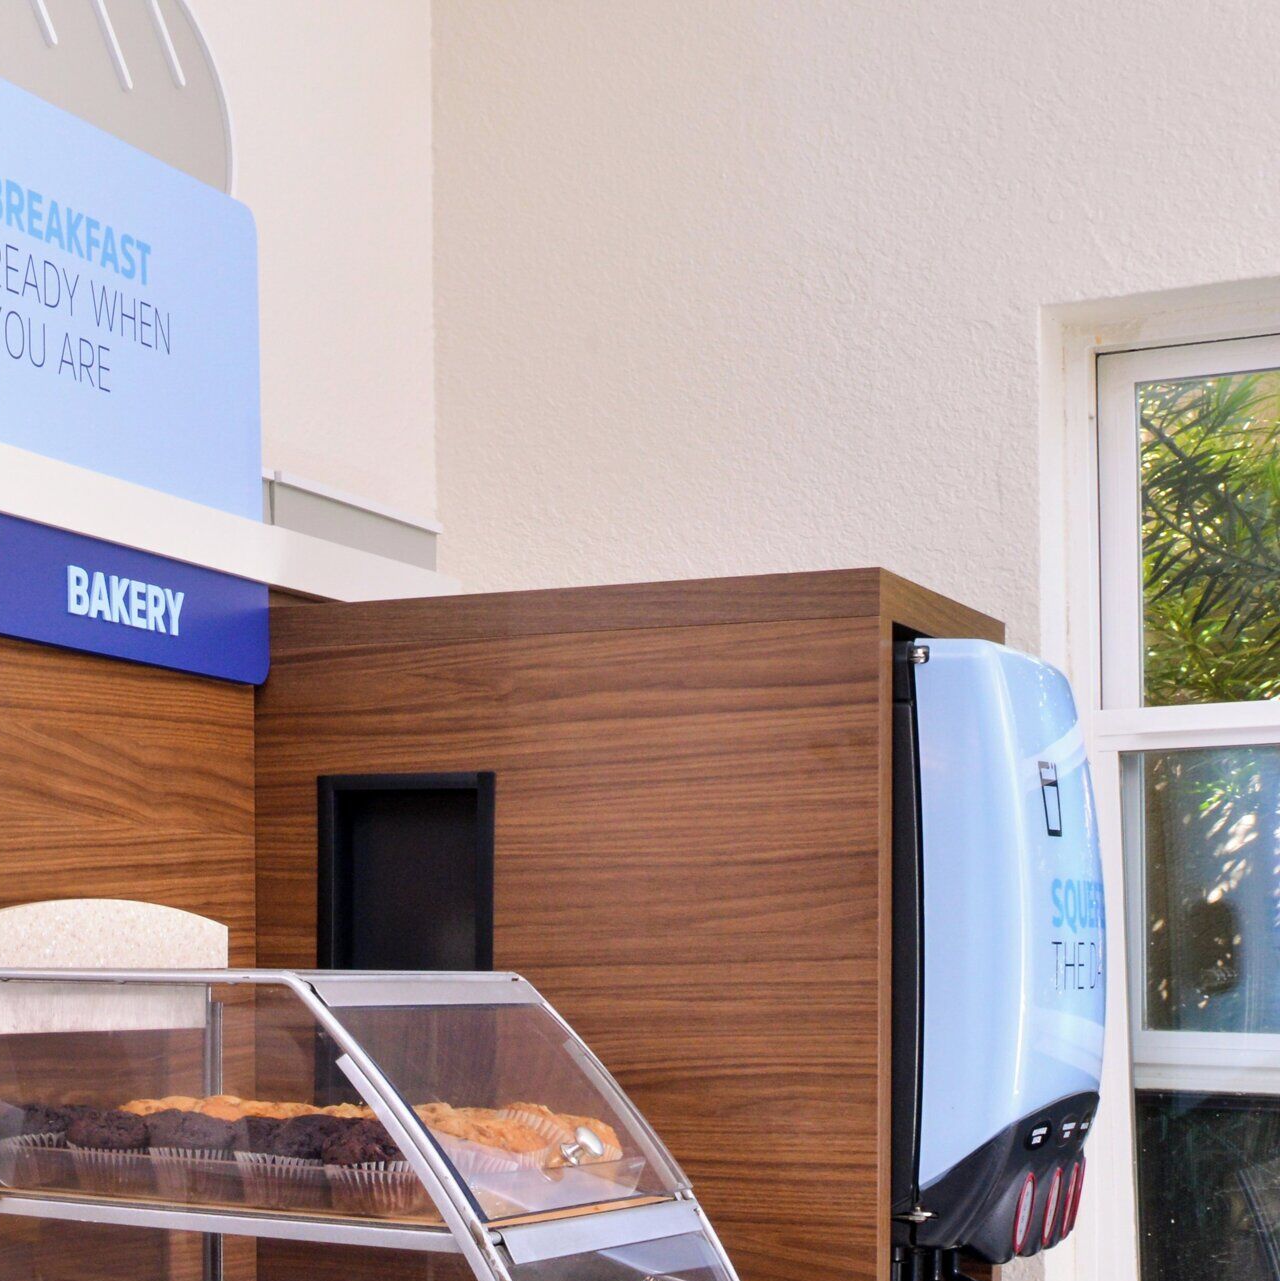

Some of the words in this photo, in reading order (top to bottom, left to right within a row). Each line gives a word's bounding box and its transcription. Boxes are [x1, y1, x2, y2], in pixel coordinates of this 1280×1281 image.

[91, 280, 170, 355] WHEN
[58, 332, 111, 393] ARE
[67, 565, 184, 636] BAKERY
